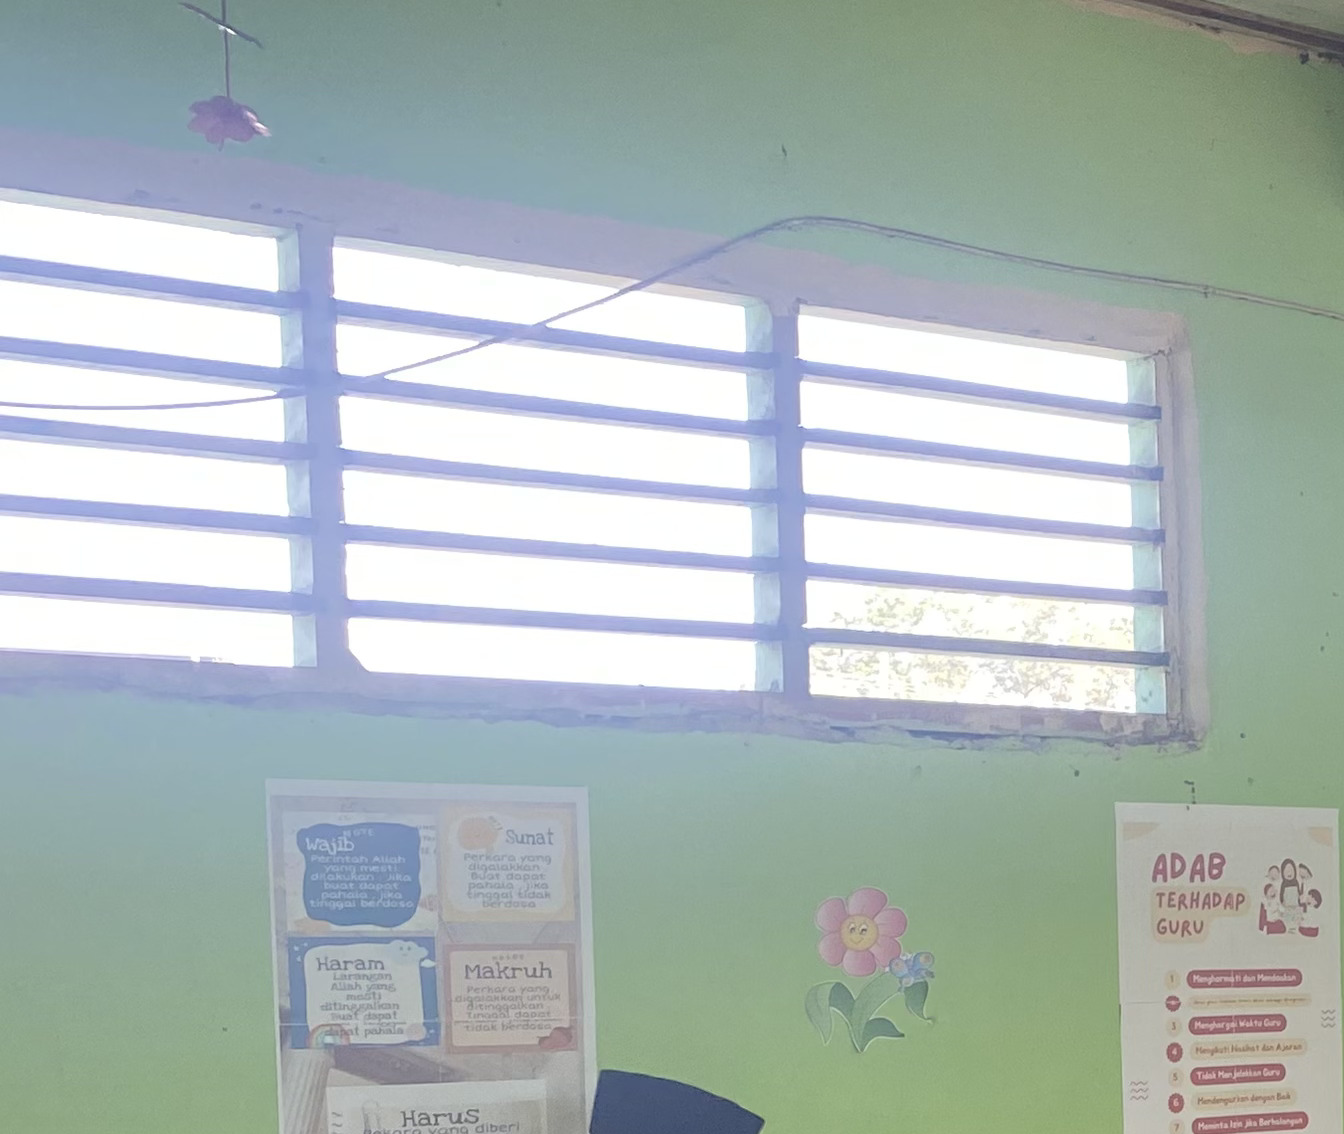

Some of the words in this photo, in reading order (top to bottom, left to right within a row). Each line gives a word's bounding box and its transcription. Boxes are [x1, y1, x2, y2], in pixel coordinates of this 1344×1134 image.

[505, 828, 554, 845] Sunat
[305, 836, 355, 855] Wajib
[310, 855, 368, 864] Perintah
[372, 855, 406, 864] Allah
[464, 852, 516, 862] Perkara
[520, 854, 551, 865] yang
[324, 864, 356, 873] yang
[360, 864, 398, 872] mesti
[1152, 852, 1226, 883] ADAB
[506, 872, 546, 882] dapat
[359, 882, 399, 892] dapat
[518, 890, 551, 899] tidak
[361, 899, 414, 908] berdosa
[482, 900, 536, 908] berdosa
[1156, 891, 1246, 911] TERHADAP
[1156, 918, 1204, 937] GURU
[316, 956, 385, 971] Haram
[464, 961, 552, 979] Makruh
[366, 982, 396, 992] yang
[466, 985, 516, 994] Perkara
[520, 986, 549, 995] yang
[527, 993, 561, 1001] untuk
[364, 1010, 397, 1022] dapat
[464, 1022, 497, 1032] tidak
[1239, 1019, 1262, 1028] Waktu
[1264, 1018, 1281, 1027] Guru
[1171, 1048, 1178, 1056] 4
[1263, 1068, 1280, 1077] Guru
[1173, 1099, 1179, 1107] 6
[475, 1122, 520, 1134] diberi
